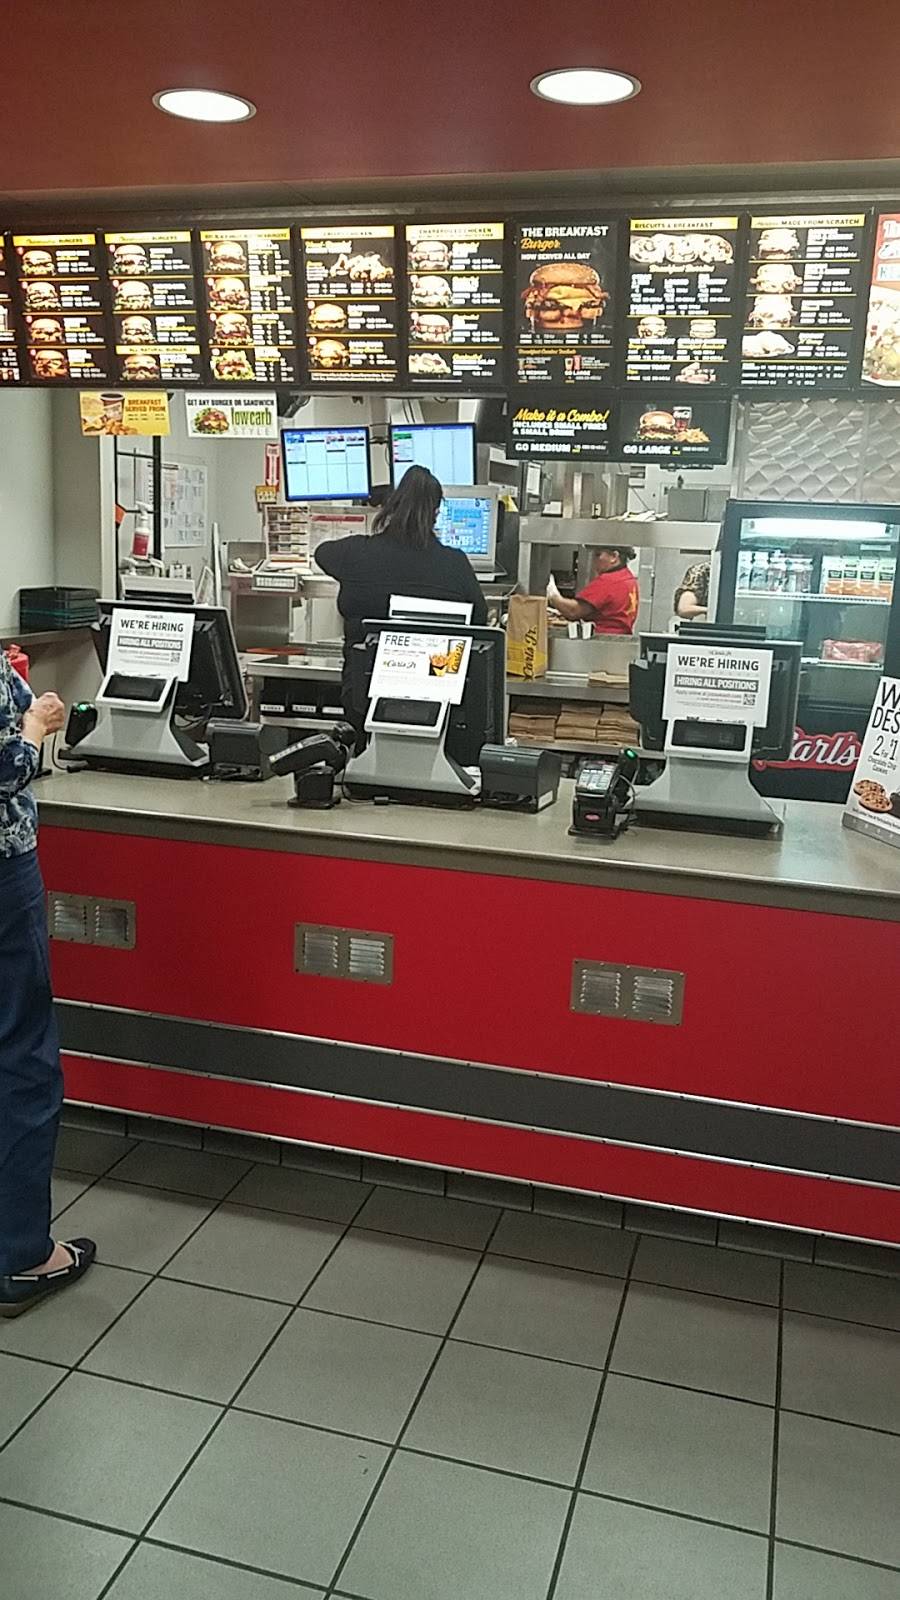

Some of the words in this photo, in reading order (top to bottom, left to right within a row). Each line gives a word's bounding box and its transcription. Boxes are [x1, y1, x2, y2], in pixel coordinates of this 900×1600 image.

[521, 228, 543, 238] THE
[545, 226, 608, 237] BREAKFAST
[520, 238, 561, 251] Burger
[577, 252, 591, 260] DAY
[187, 399, 196, 407] GET
[198, 399, 210, 407] ANY
[211, 399, 232, 407] BURGER
[243, 399, 275, 407] SANDWICH
[512, 409, 545, 421] Make
[546, 409, 556, 421] it
[566, 409, 609, 423] Combo!
[554, 422, 581, 430] SMALL
[515, 444, 530, 452] GO
[531, 444, 571, 452] MEDIUM
[623, 446, 639, 454] GO
[641, 446, 671, 455] LARGE
[120, 619, 150, 630] WE'RE
[152, 621, 184, 632] HIRING
[384, 634, 411, 647] FREE
[677, 655, 715, 669] WE'RE
[717, 658, 759, 671] HIRING
[676, 676, 703, 687] HIRING
[703, 678, 717, 688] ALL
[717, 679, 757, 692] POSITIONS
[789, 732, 861, 768] arl's
[873, 735, 885, 756] 2
